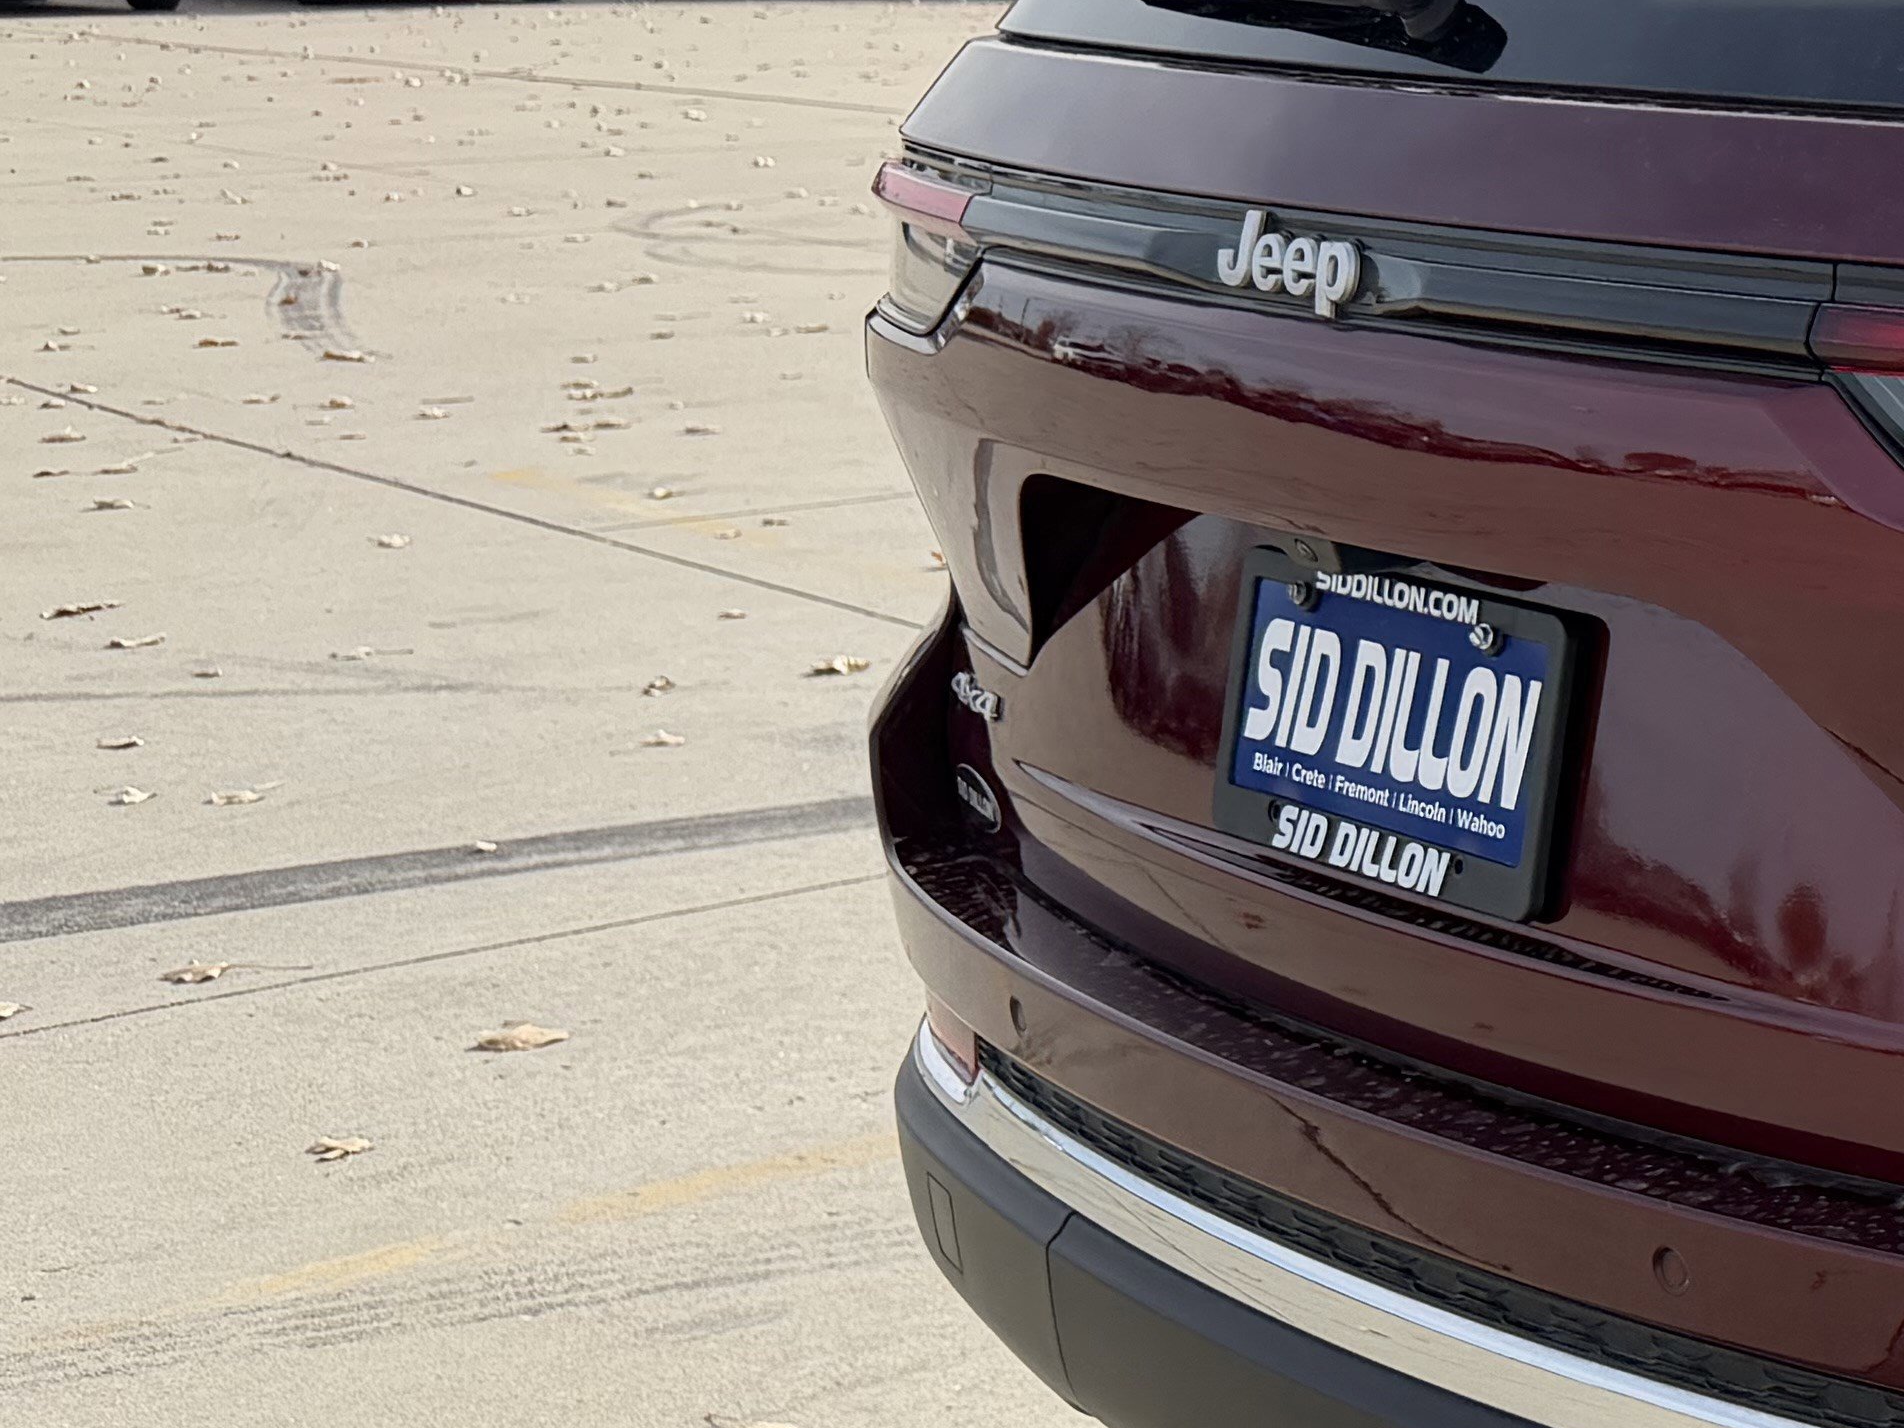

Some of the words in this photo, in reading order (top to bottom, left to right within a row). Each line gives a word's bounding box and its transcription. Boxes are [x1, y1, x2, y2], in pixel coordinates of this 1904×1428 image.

[1217, 209, 1361, 319] Jeep
[1315, 571, 1480, 625] SIDDILLON.COM
[1243, 617, 1342, 756] SID
[1335, 639, 1543, 811] DILLON
[1252, 752, 1283, 777] Blair
[1291, 763, 1326, 790] Crete
[1334, 775, 1391, 806] Fremont
[1398, 792, 1447, 823] Lincoln
[1456, 807, 1506, 840] Wahoo
[1271, 803, 1329, 860] SID
[1327, 820, 1452, 898] DILLON
